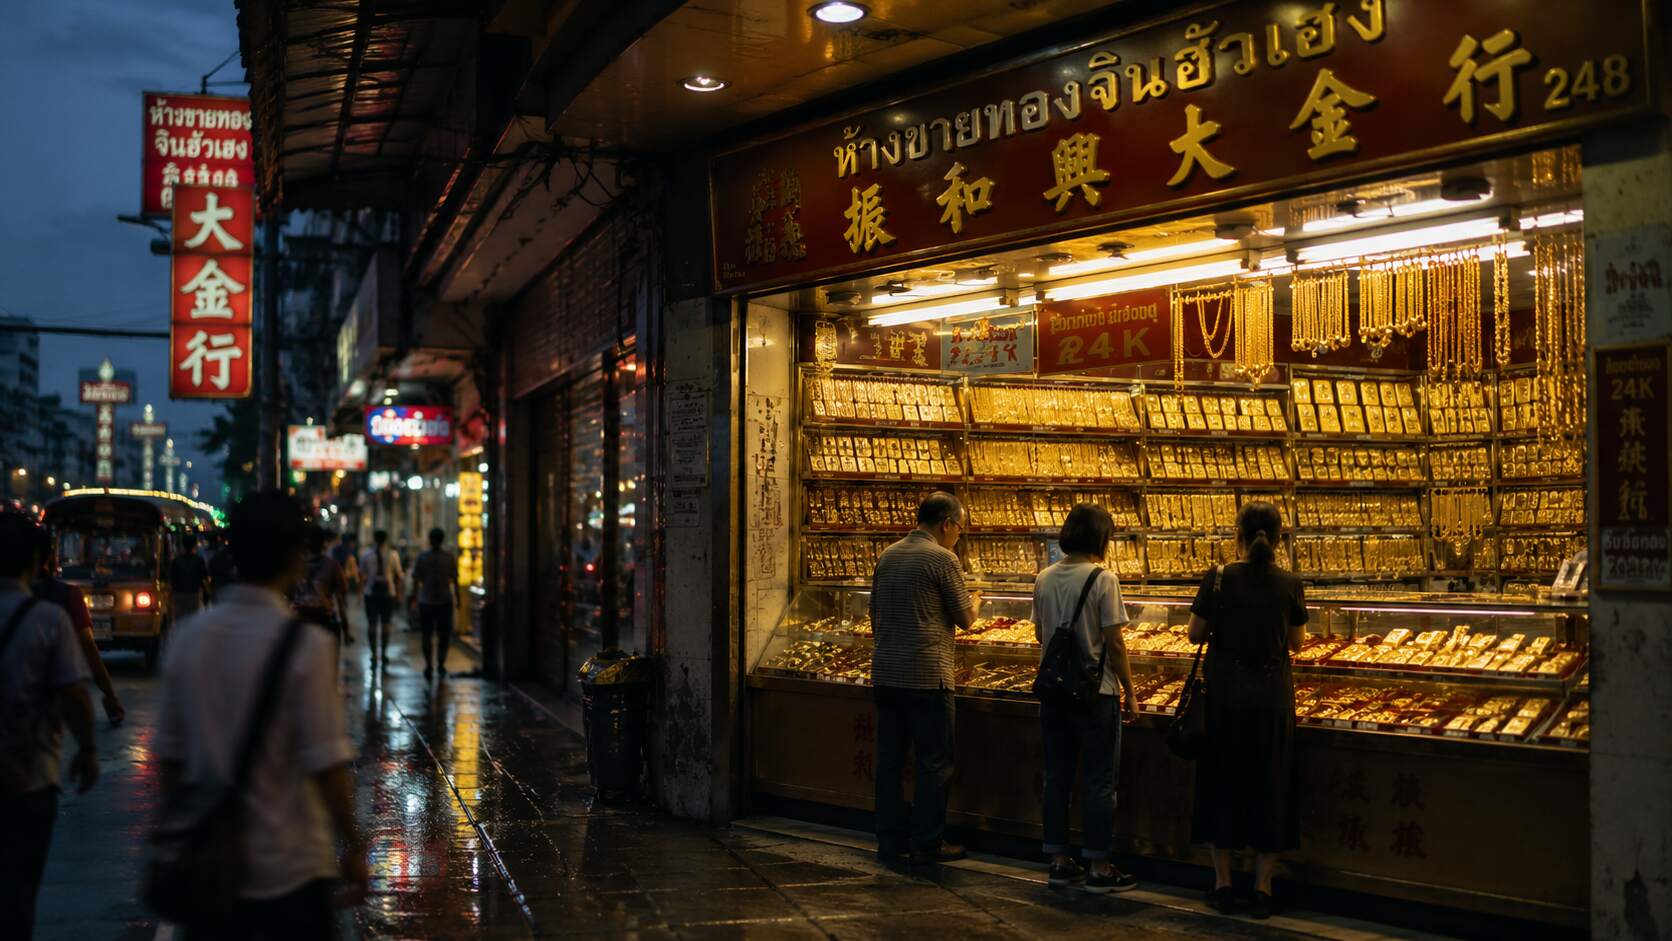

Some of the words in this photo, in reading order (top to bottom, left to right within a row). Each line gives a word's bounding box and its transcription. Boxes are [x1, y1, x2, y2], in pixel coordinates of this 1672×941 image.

[1543, 55, 1631, 111] 248
[150, 98, 252, 131] ห้างขายทอง
[843, 28, 1532, 255] 振和興大金行
[179, 192, 245, 390] 大金行
[1610, 376, 1655, 400] 24K
